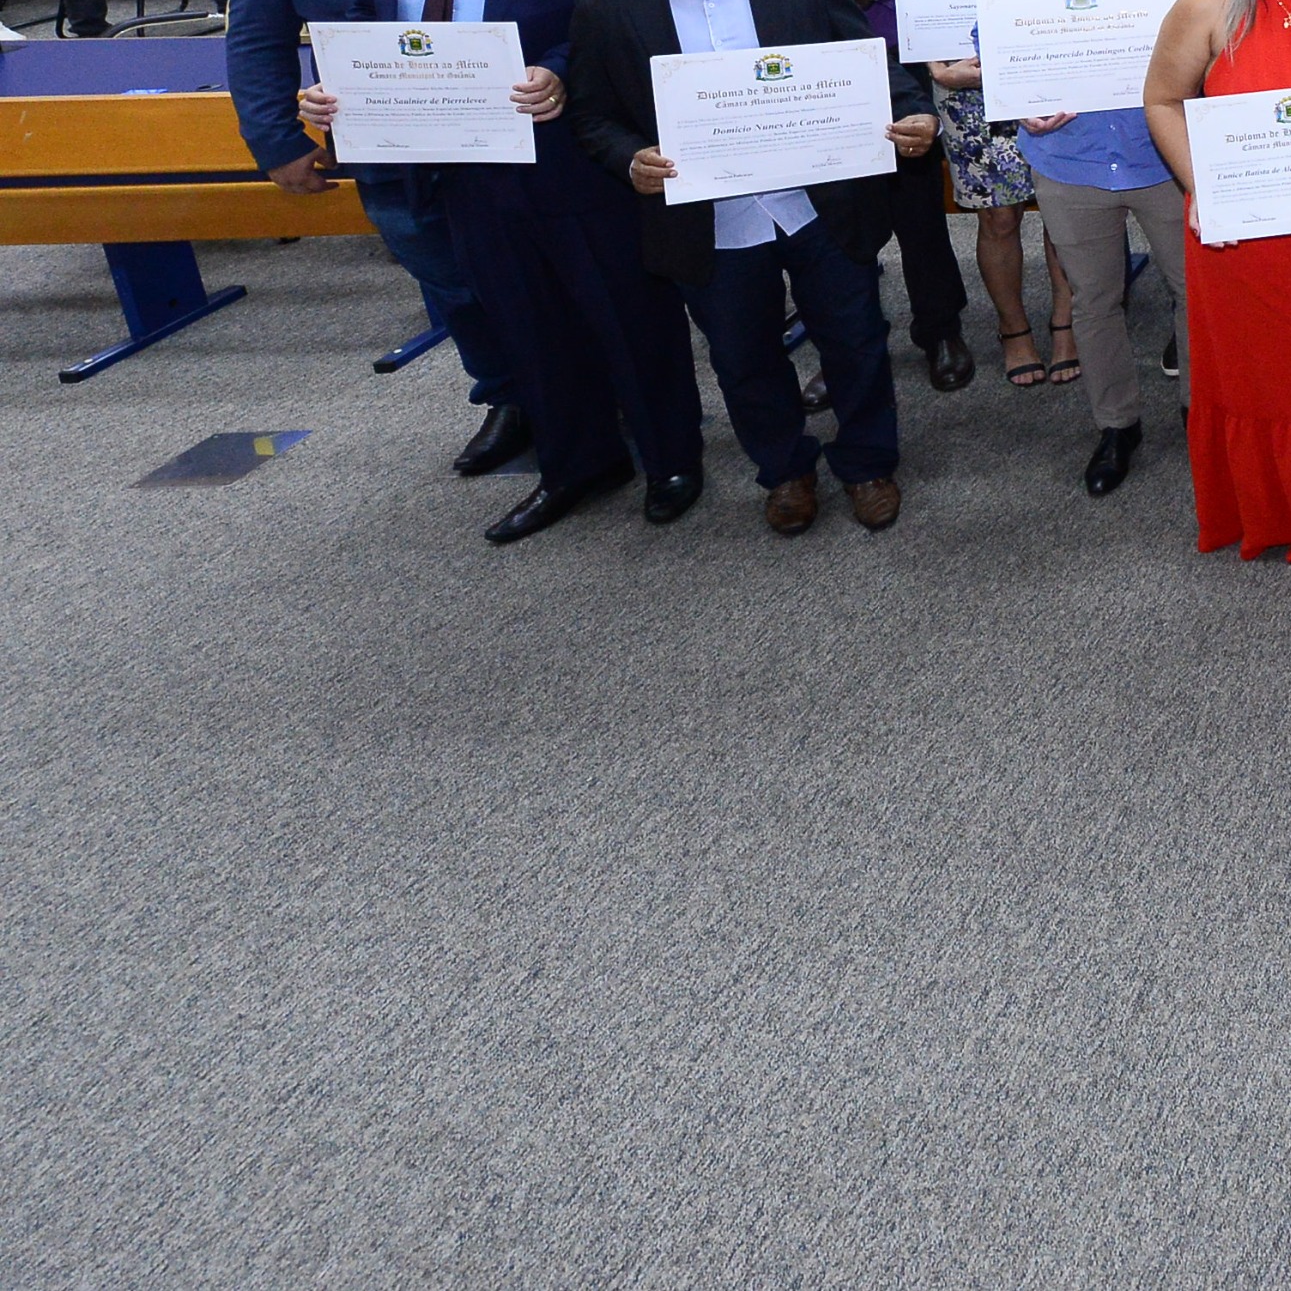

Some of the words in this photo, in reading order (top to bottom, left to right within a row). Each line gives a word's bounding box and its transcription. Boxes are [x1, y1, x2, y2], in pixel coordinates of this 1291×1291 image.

[365, 97, 392, 105] Daniel
[393, 97, 428, 105] Saulnier
[755, 123, 783, 132] Nunes
[786, 120, 798, 128] de
[800, 116, 841, 127] Carvalho
